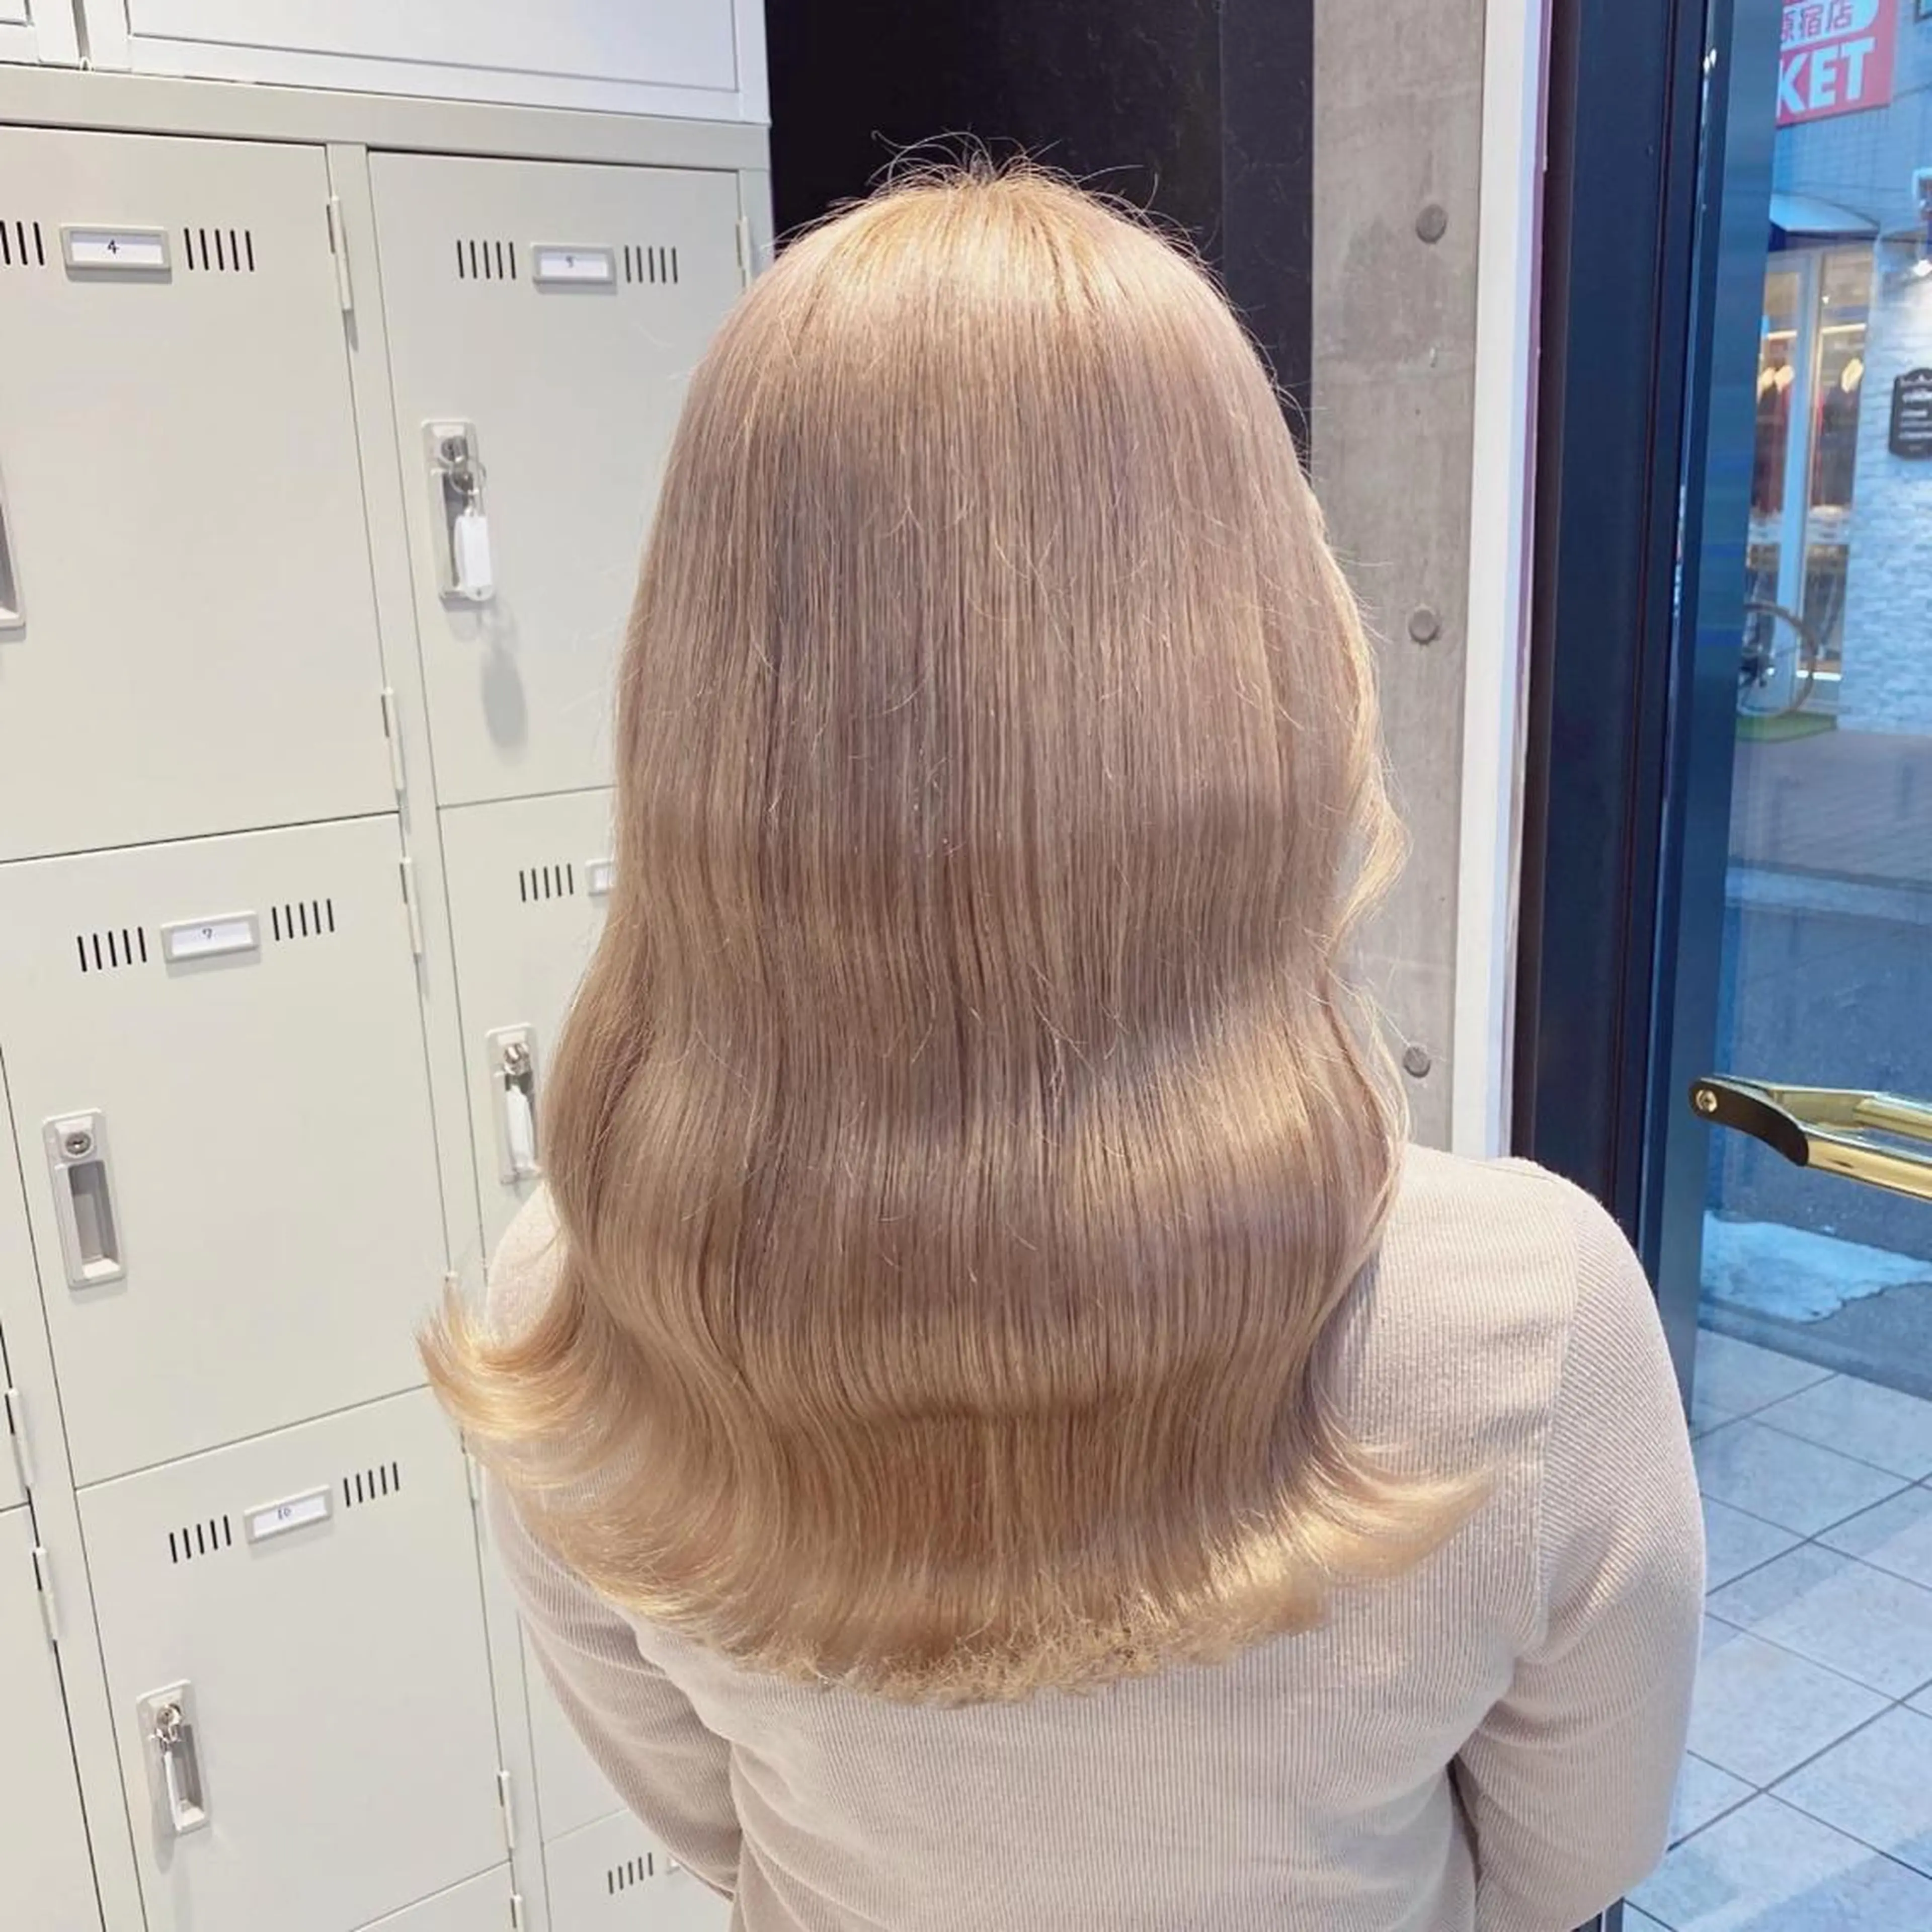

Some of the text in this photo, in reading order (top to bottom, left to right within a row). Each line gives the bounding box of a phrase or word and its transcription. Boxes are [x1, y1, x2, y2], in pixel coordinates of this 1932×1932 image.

[1777, 37, 1875, 117] KET
[107, 239, 119, 254] 4
[278, 1507, 291, 1520] 10
